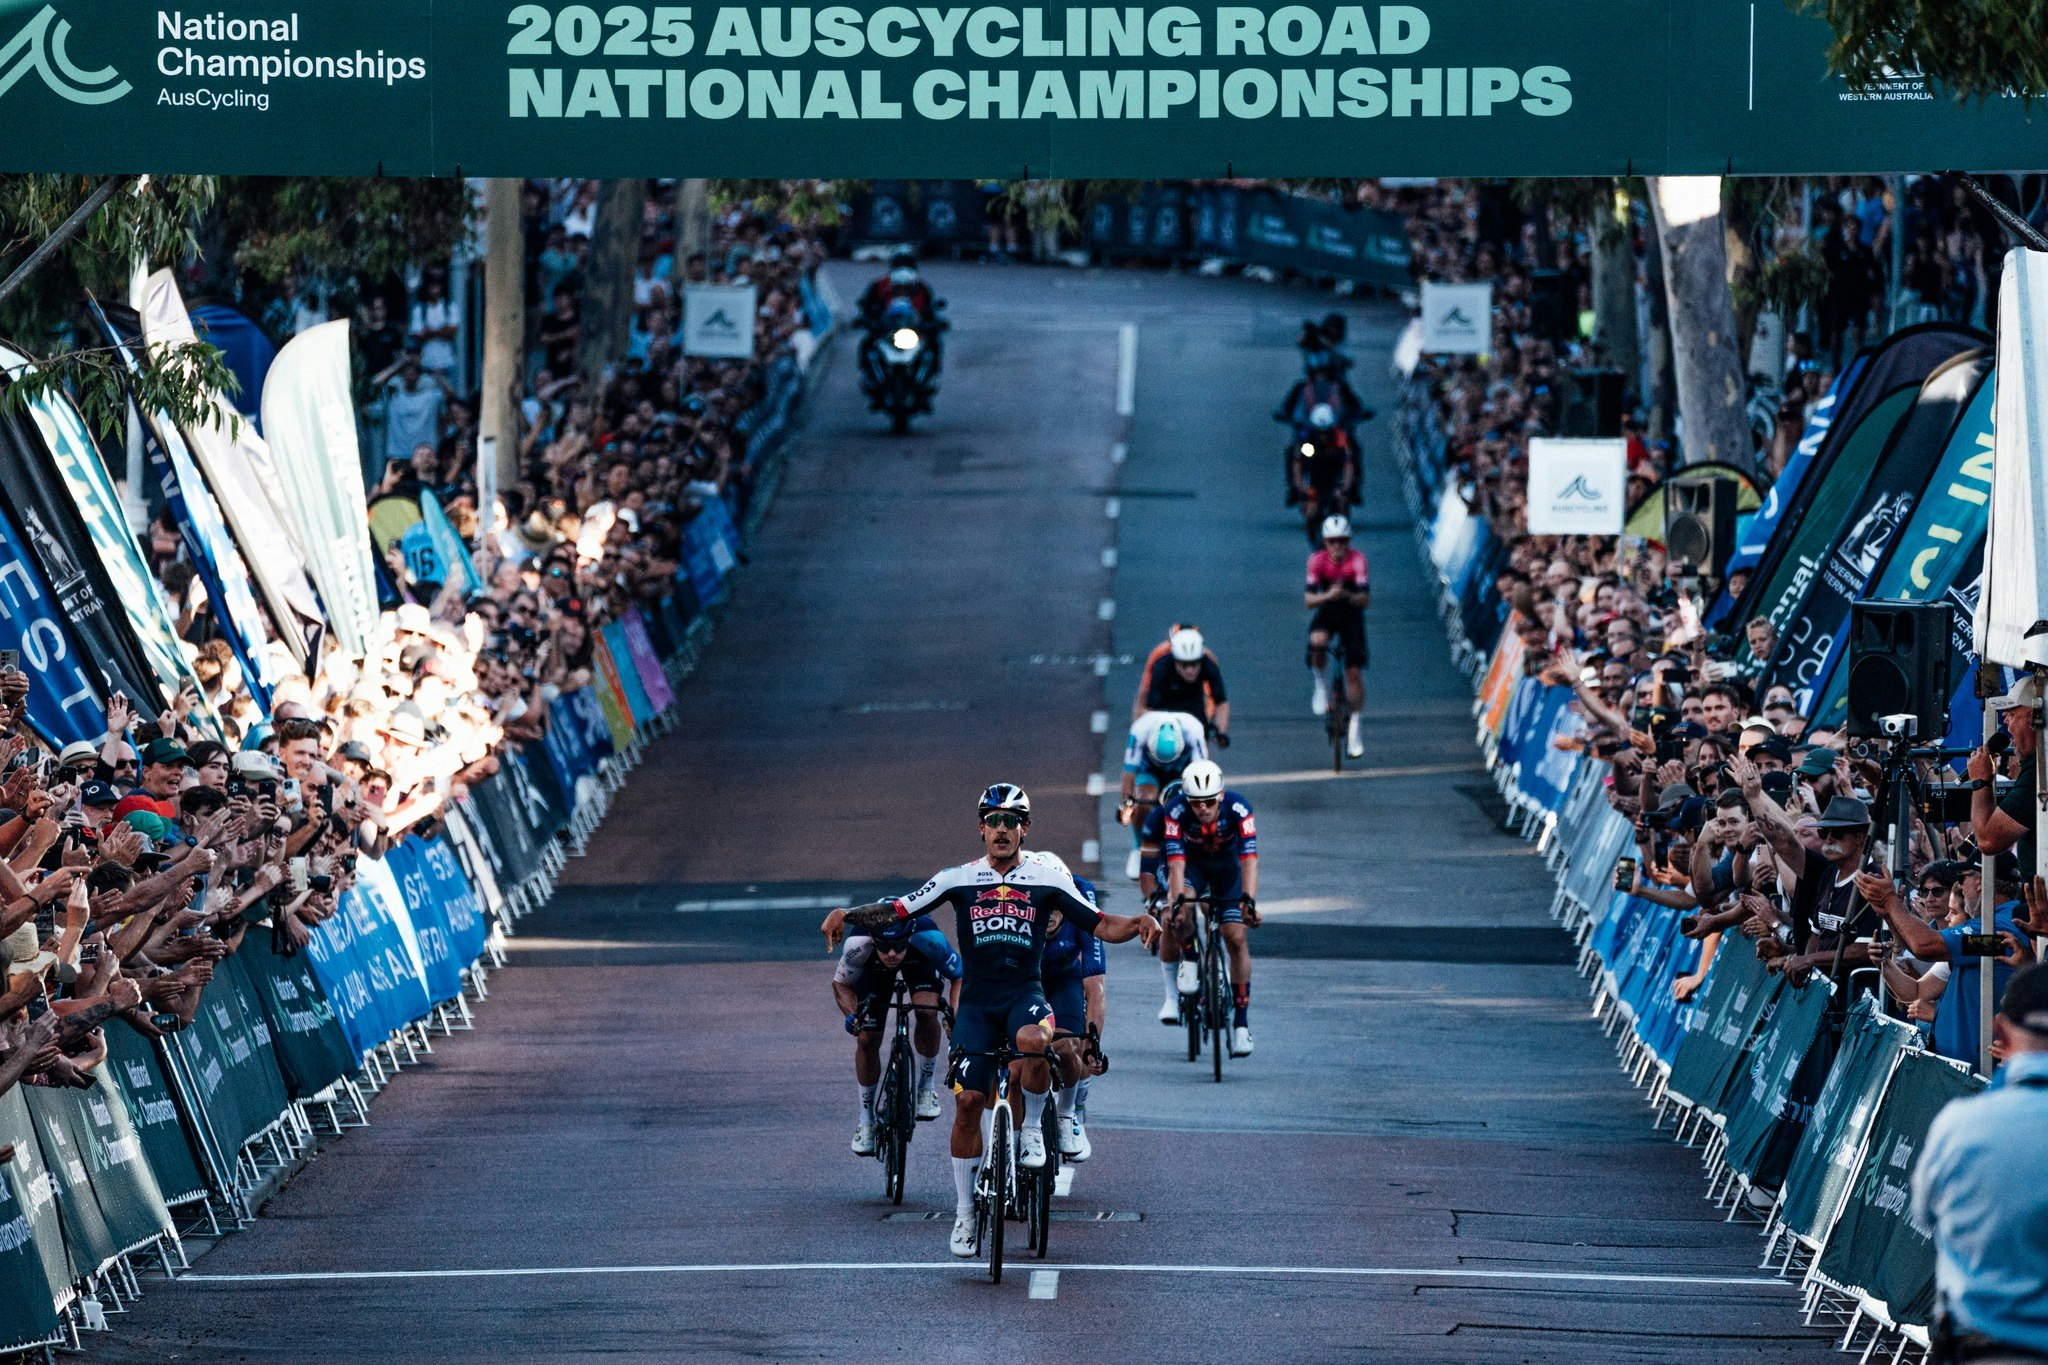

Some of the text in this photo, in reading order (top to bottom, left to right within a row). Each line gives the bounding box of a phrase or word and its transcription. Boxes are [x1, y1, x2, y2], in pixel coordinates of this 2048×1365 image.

[157, 11, 299, 42] National
[507, 5, 1431, 57] 2025 AUSCYCLING ROAD
[157, 47, 426, 86] Championships
[509, 66, 1573, 120] NATIONAL CHAMPIONSHIPS
[1838, 92, 1934, 101] WESTERN AUSTRALIA
[1848, 82, 1925, 91] VENMENT OF
[157, 88, 270, 111] AusCycling
[908, 880, 937, 902] BOSS
[970, 901, 1036, 923] Red Bull
[972, 916, 1033, 937] BORA
[976, 933, 1031, 946] hansgrohe
